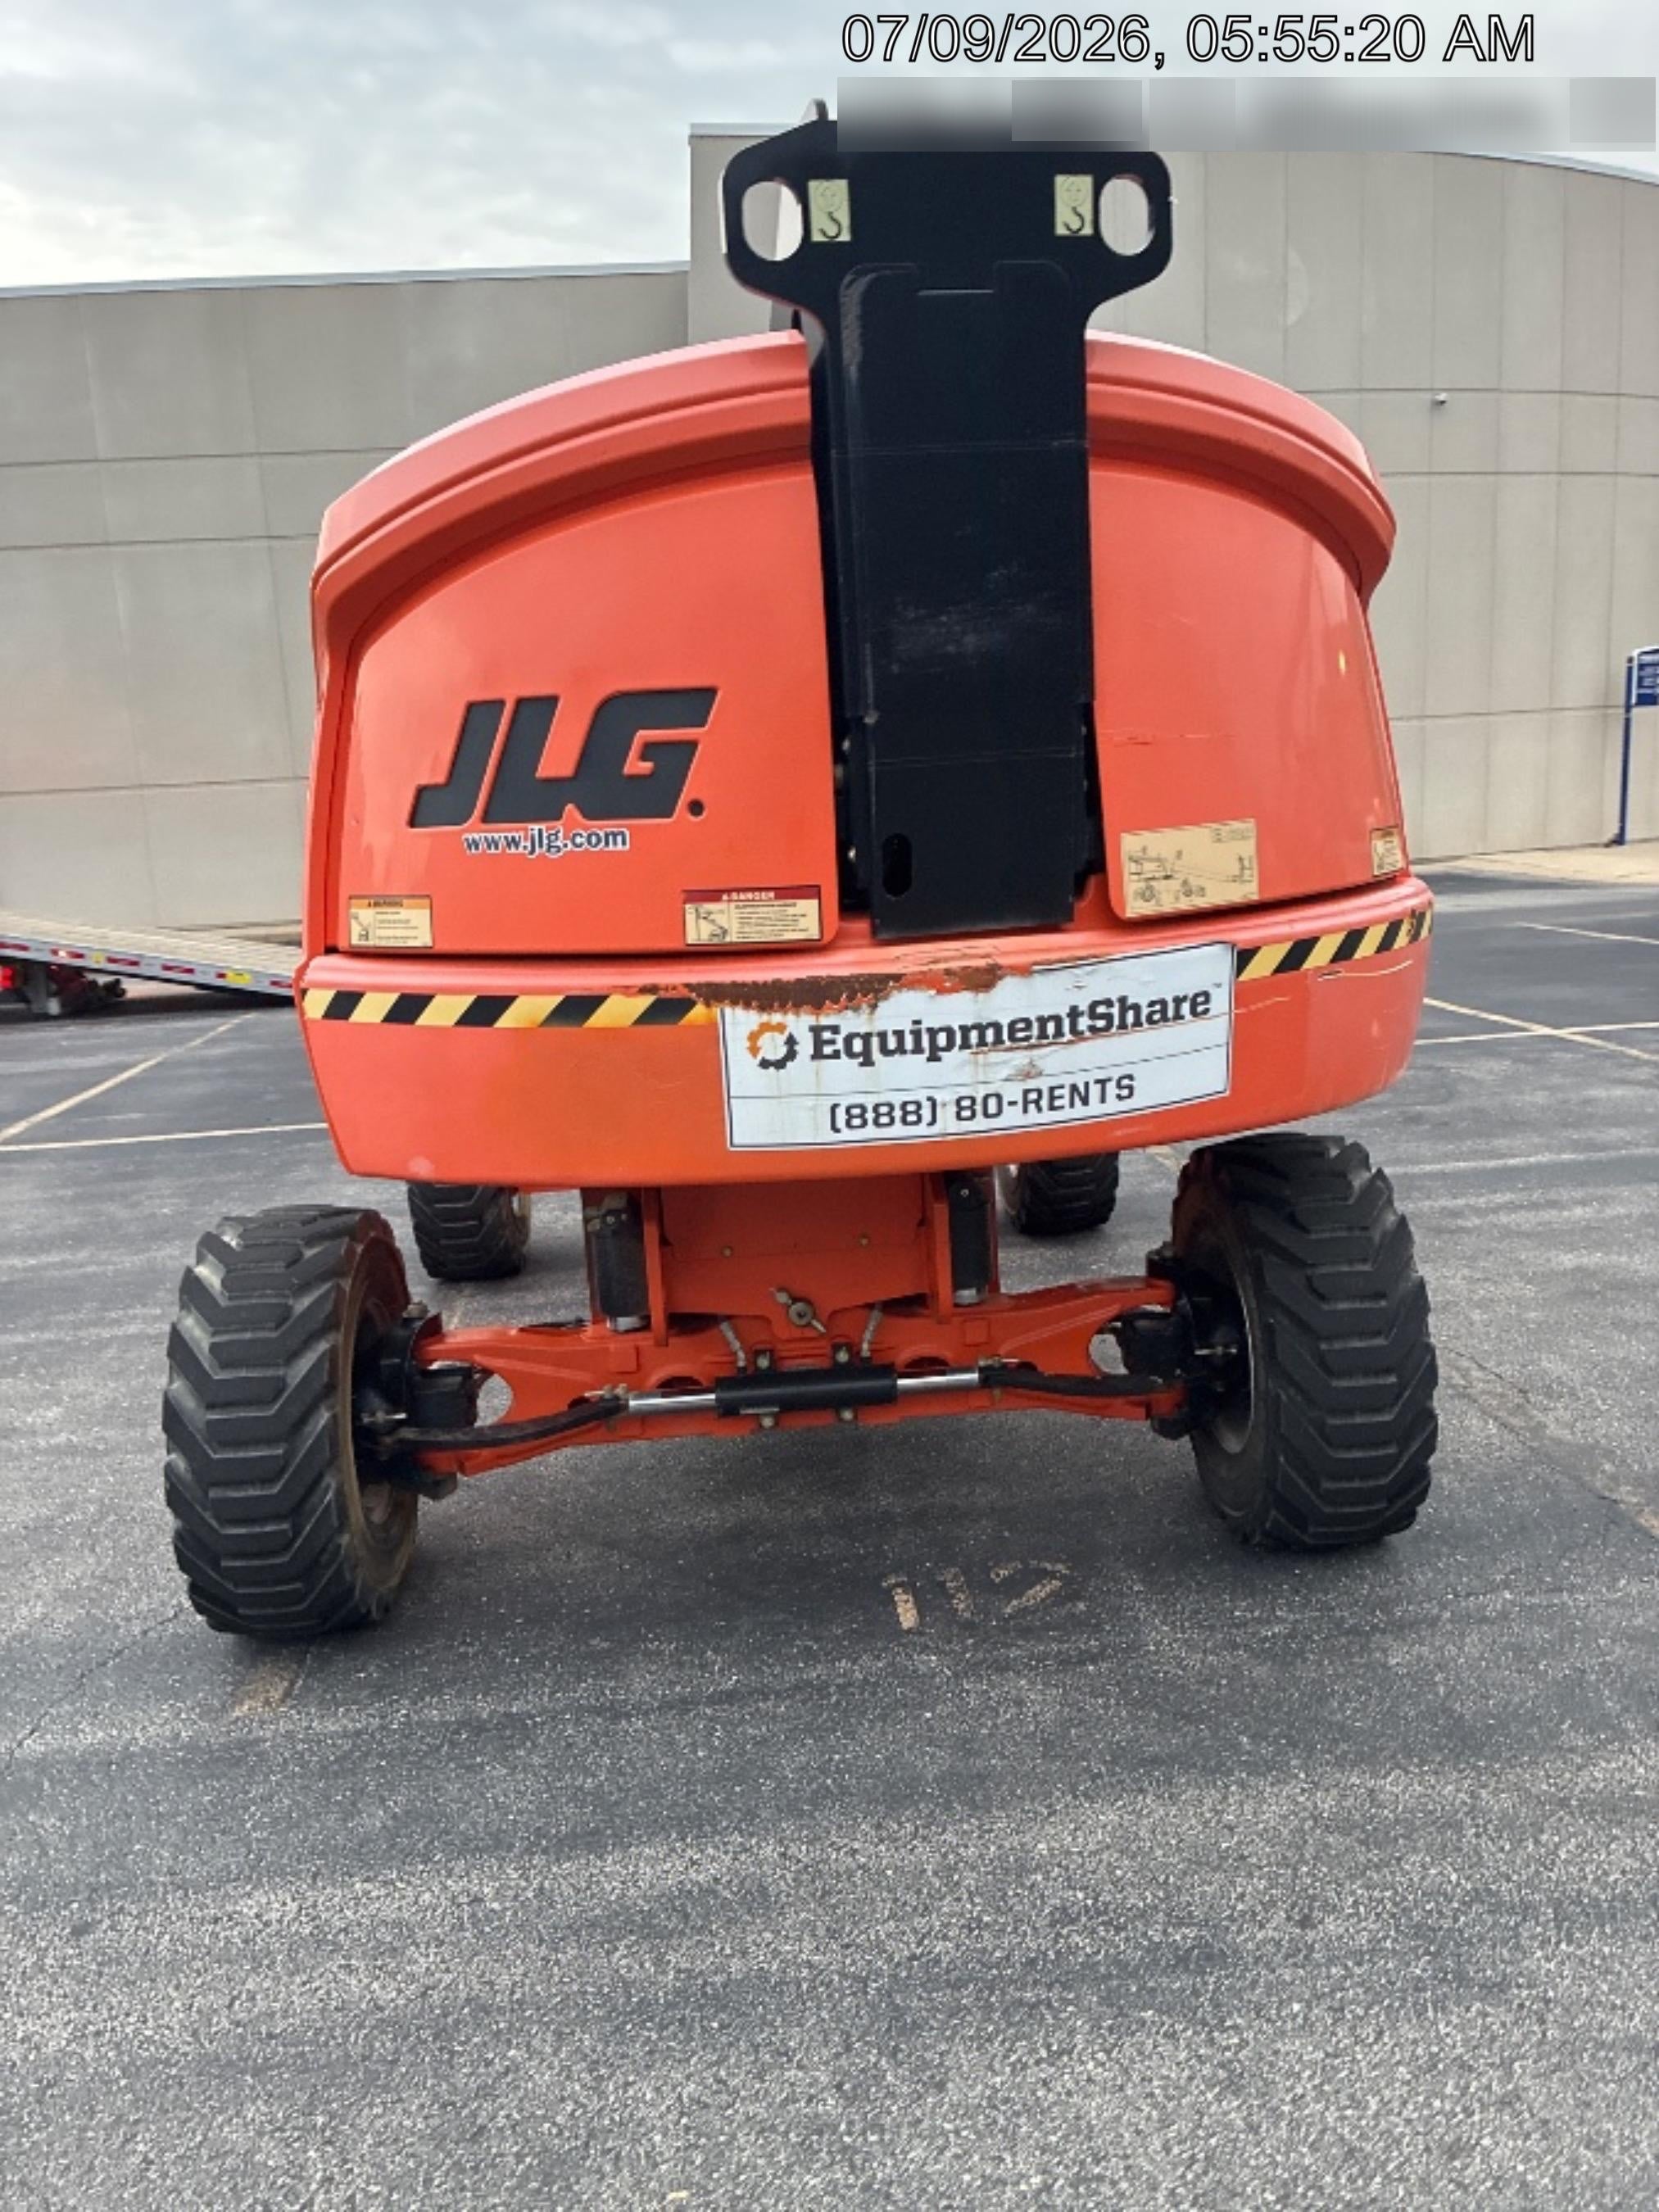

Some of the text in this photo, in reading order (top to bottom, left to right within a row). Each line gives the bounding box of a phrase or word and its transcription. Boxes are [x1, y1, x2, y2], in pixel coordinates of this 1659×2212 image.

[465, 827, 627, 856] www.jlg.com
[809, 989, 1212, 1067] EquipmentShare
[830, 1073, 1136, 1133] (888) 80-RENTS
